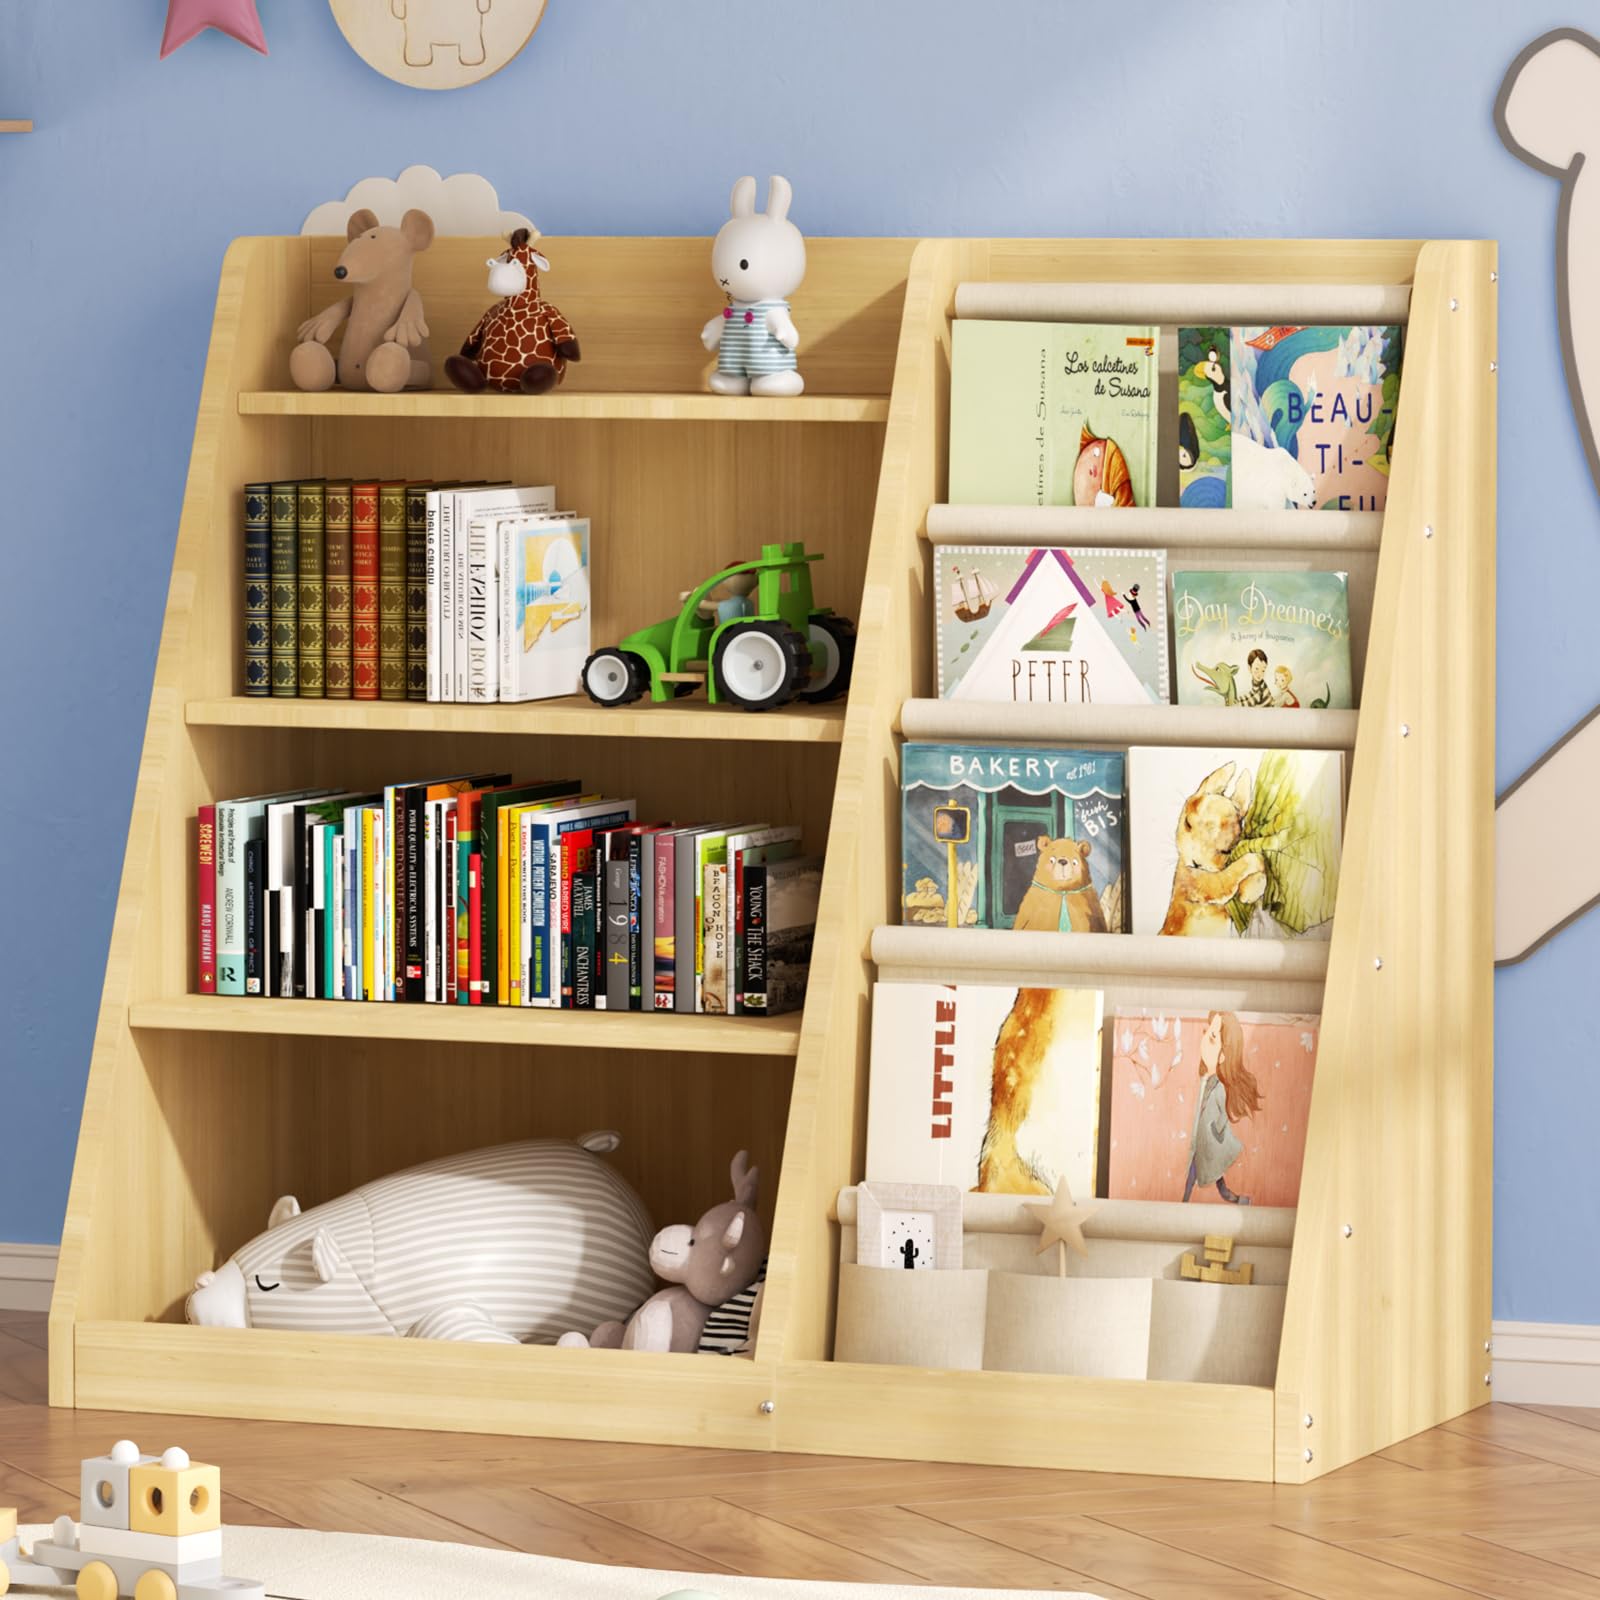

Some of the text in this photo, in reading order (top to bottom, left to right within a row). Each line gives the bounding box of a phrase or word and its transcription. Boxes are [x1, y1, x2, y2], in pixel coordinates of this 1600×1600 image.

[1064, 351, 1138, 375] Los calcetines
[1036, 349, 1047, 421] Susana
[1095, 377, 1151, 398] de Susana
[1288, 392, 1393, 424] BEAU-
[1035, 427, 1044, 448] de
[1315, 444, 1363, 474] TI-
[1175, 580, 1344, 641] Day Dreamers
[1012, 659, 1092, 703] PETER
[950, 755, 1060, 779] BAKERY
[409, 809, 417, 832] POWER
[408, 834, 417, 864] QUALITY
[409, 871, 417, 913] ELECTRICAL
[573, 878, 583, 917] MAXWELL
[583, 885, 593, 911] JAMES
[749, 885, 764, 918] YOUNG
[225, 888, 234, 945] ANDREW CORNWALL
[409, 914, 417, 947] SYSTEMS
[747, 926, 765, 981] THE SHACK
[576, 946, 590, 1005] ENCHANTRESS
[931, 1000, 957, 1139] LITTLE
